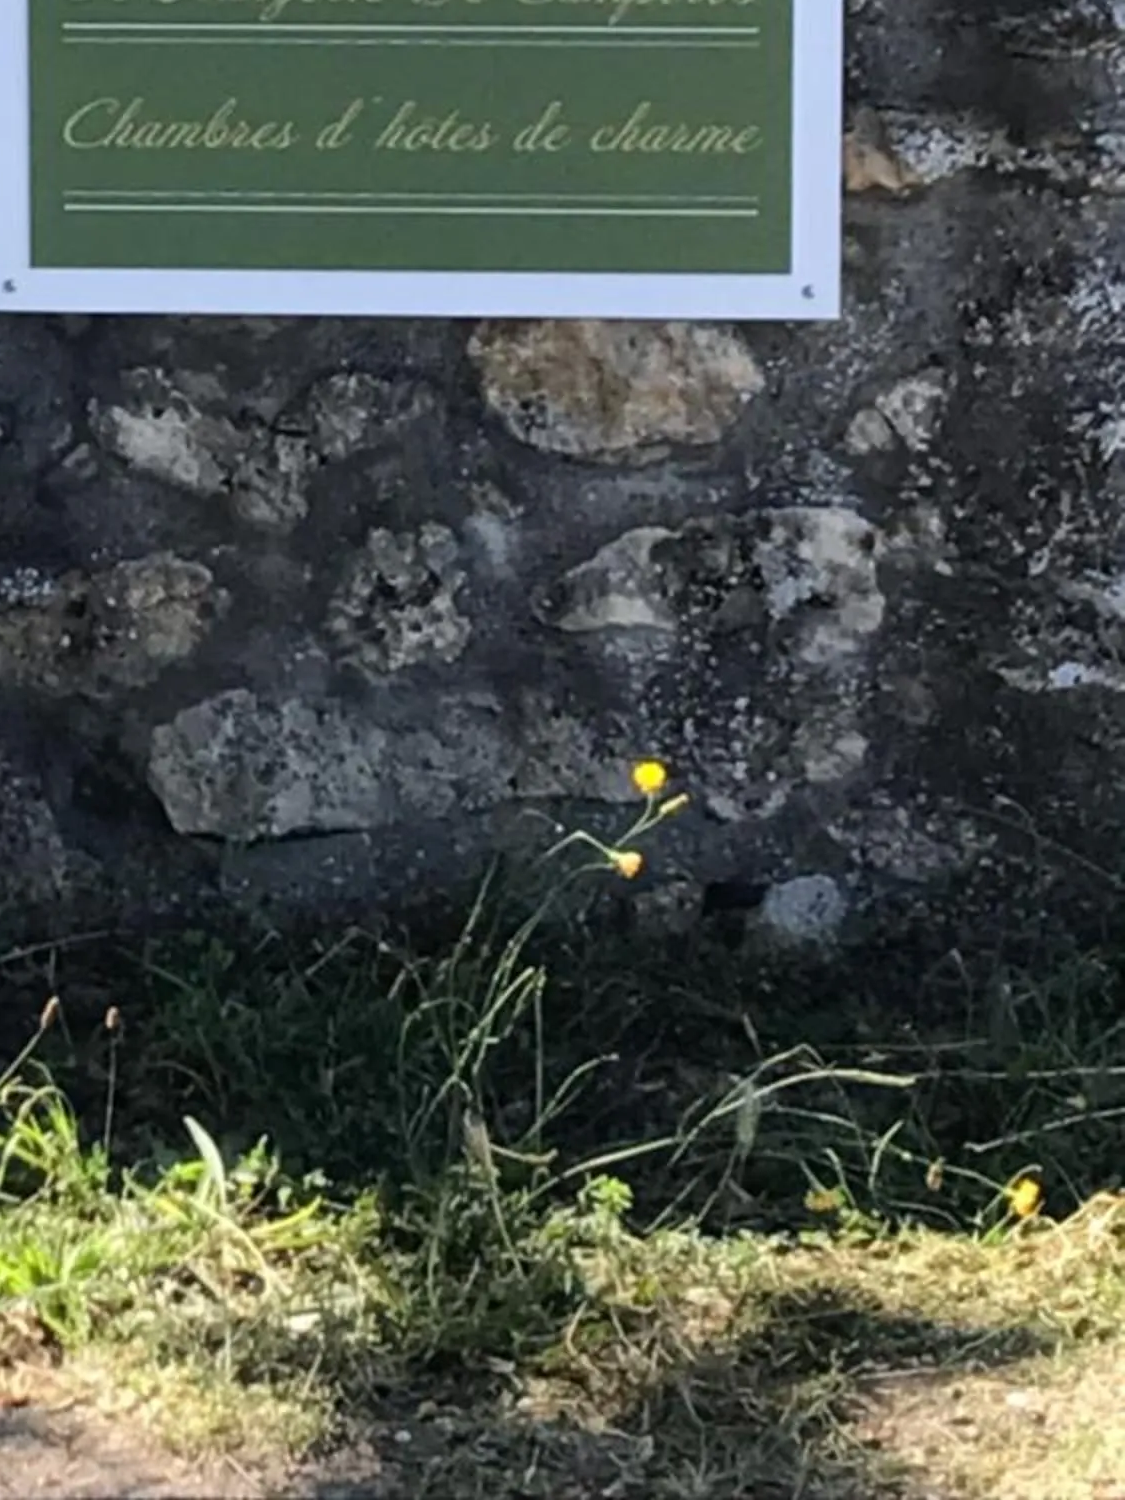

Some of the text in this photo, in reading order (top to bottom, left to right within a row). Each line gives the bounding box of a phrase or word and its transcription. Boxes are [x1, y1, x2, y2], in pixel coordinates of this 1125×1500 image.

[62, 97, 300, 150] Chambres
[513, 100, 572, 152] de
[589, 100, 764, 153] charme
